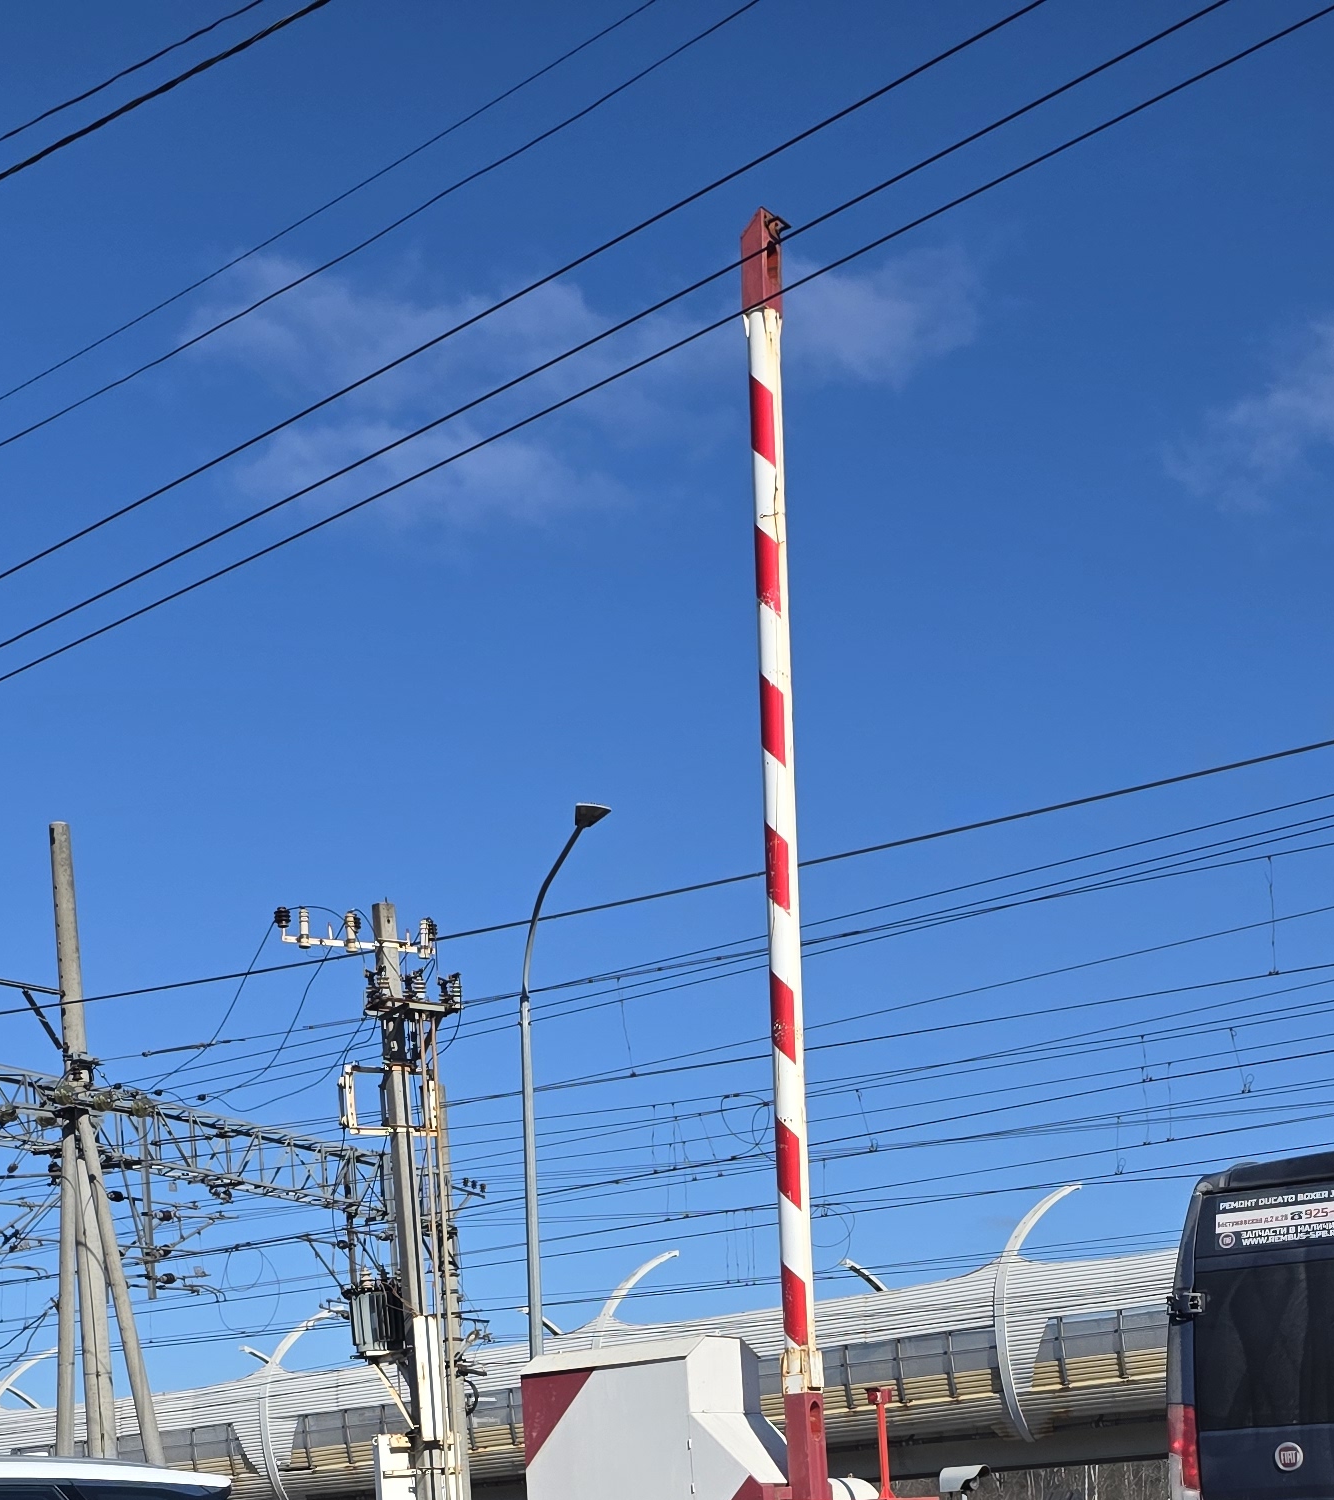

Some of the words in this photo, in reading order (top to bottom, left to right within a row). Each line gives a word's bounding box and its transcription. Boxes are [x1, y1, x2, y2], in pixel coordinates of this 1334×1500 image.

[1219, 1198, 1257, 1210] РЕМОНТ
[1258, 1194, 1295, 1206] DUCATO
[1297, 1190, 1329, 1201] BOXER
[1240, 1227, 1287, 1239] ЗАПЧАСТИ
[1280, 1450, 1297, 1464] FIAT
